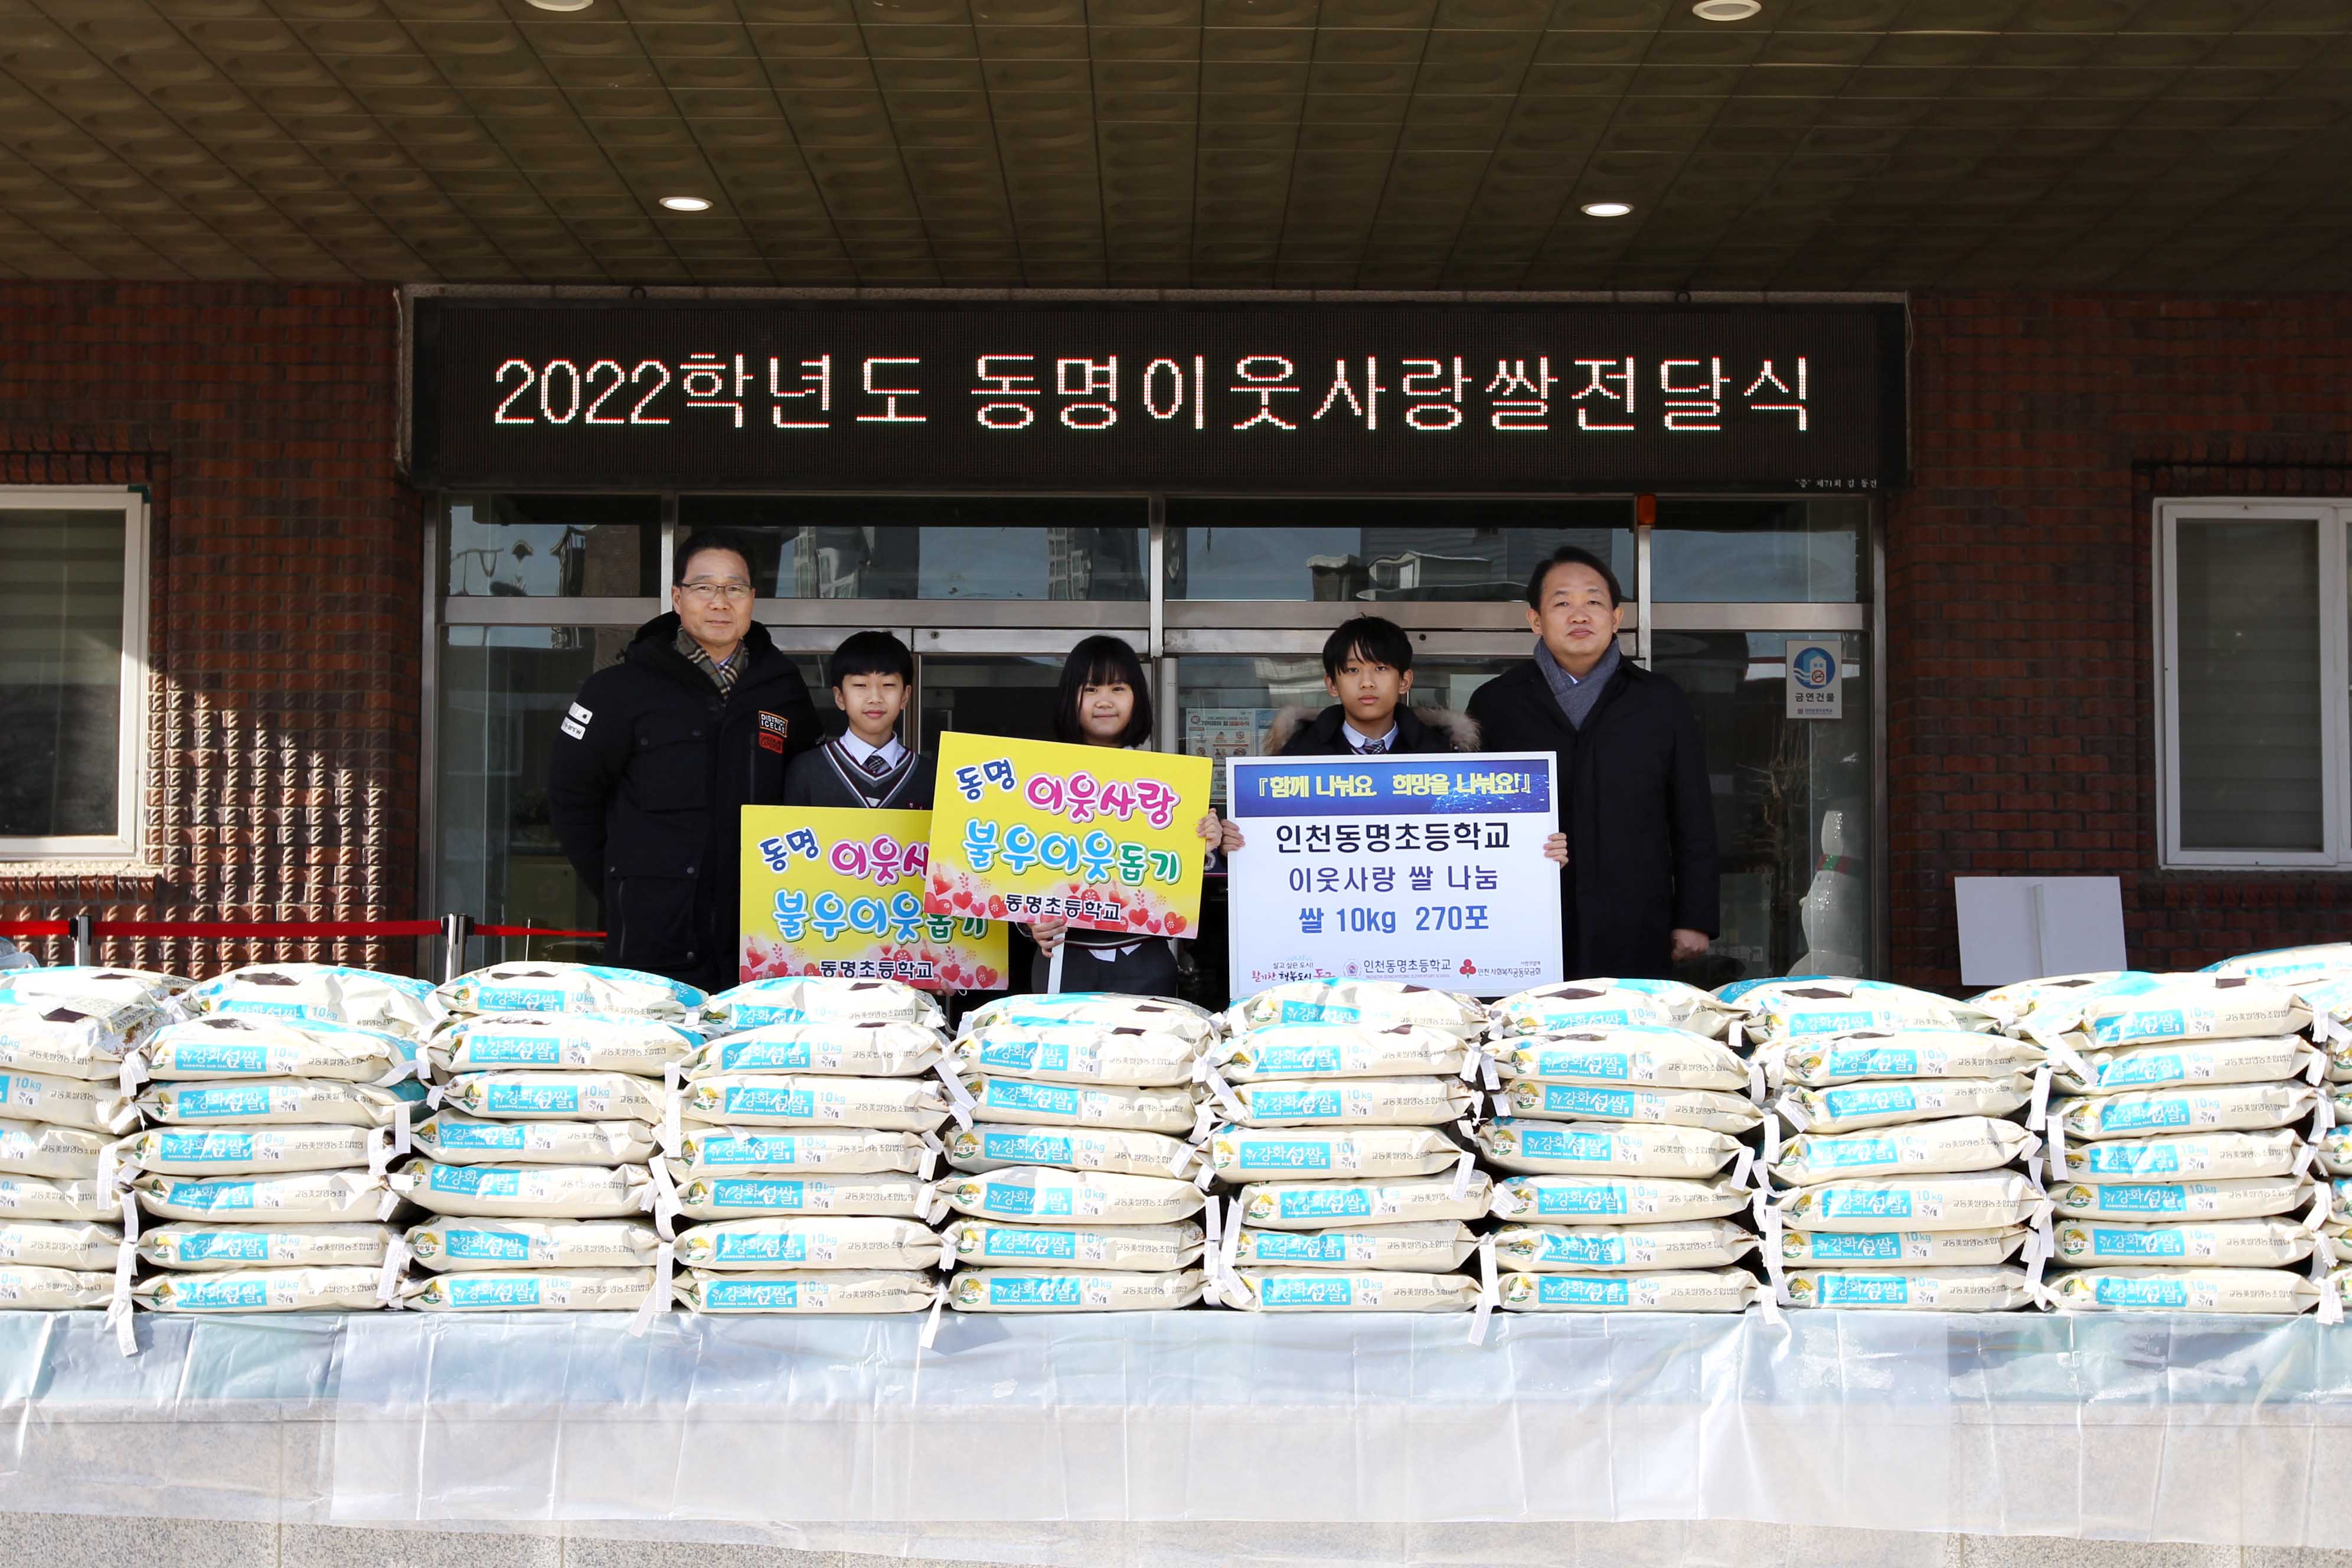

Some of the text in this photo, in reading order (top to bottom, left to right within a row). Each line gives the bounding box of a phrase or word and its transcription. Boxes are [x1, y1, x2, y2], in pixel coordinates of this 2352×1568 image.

[495, 354, 1807, 431] 2022학년도 동명이웃사랑쌀전달식
[1795, 692, 1834, 703] 금연건물
[956, 758, 1016, 801] 동명
[1392, 773, 1449, 796] 희망을
[1026, 773, 1177, 825] 이웃사랑
[759, 827, 819, 872] 동명
[963, 820, 1178, 882] 불우이웃돕기
[1276, 822, 1510, 853] 인천동명초등학교
[831, 837, 930, 882] 이웃사
[1289, 865, 1498, 893] 이웃사랑 쌀 나눔
[1005, 893, 1122, 921] 동명초등학교
[1298, 905, 1489, 934] 쌀 10kg 270포
[820, 960, 933, 979] 동명초등학교
[1364, 959, 1452, 974] 인천동명초등학교
[312, 1006, 338, 1021] 10kg
[14, 1076, 43, 1092] 10kg
